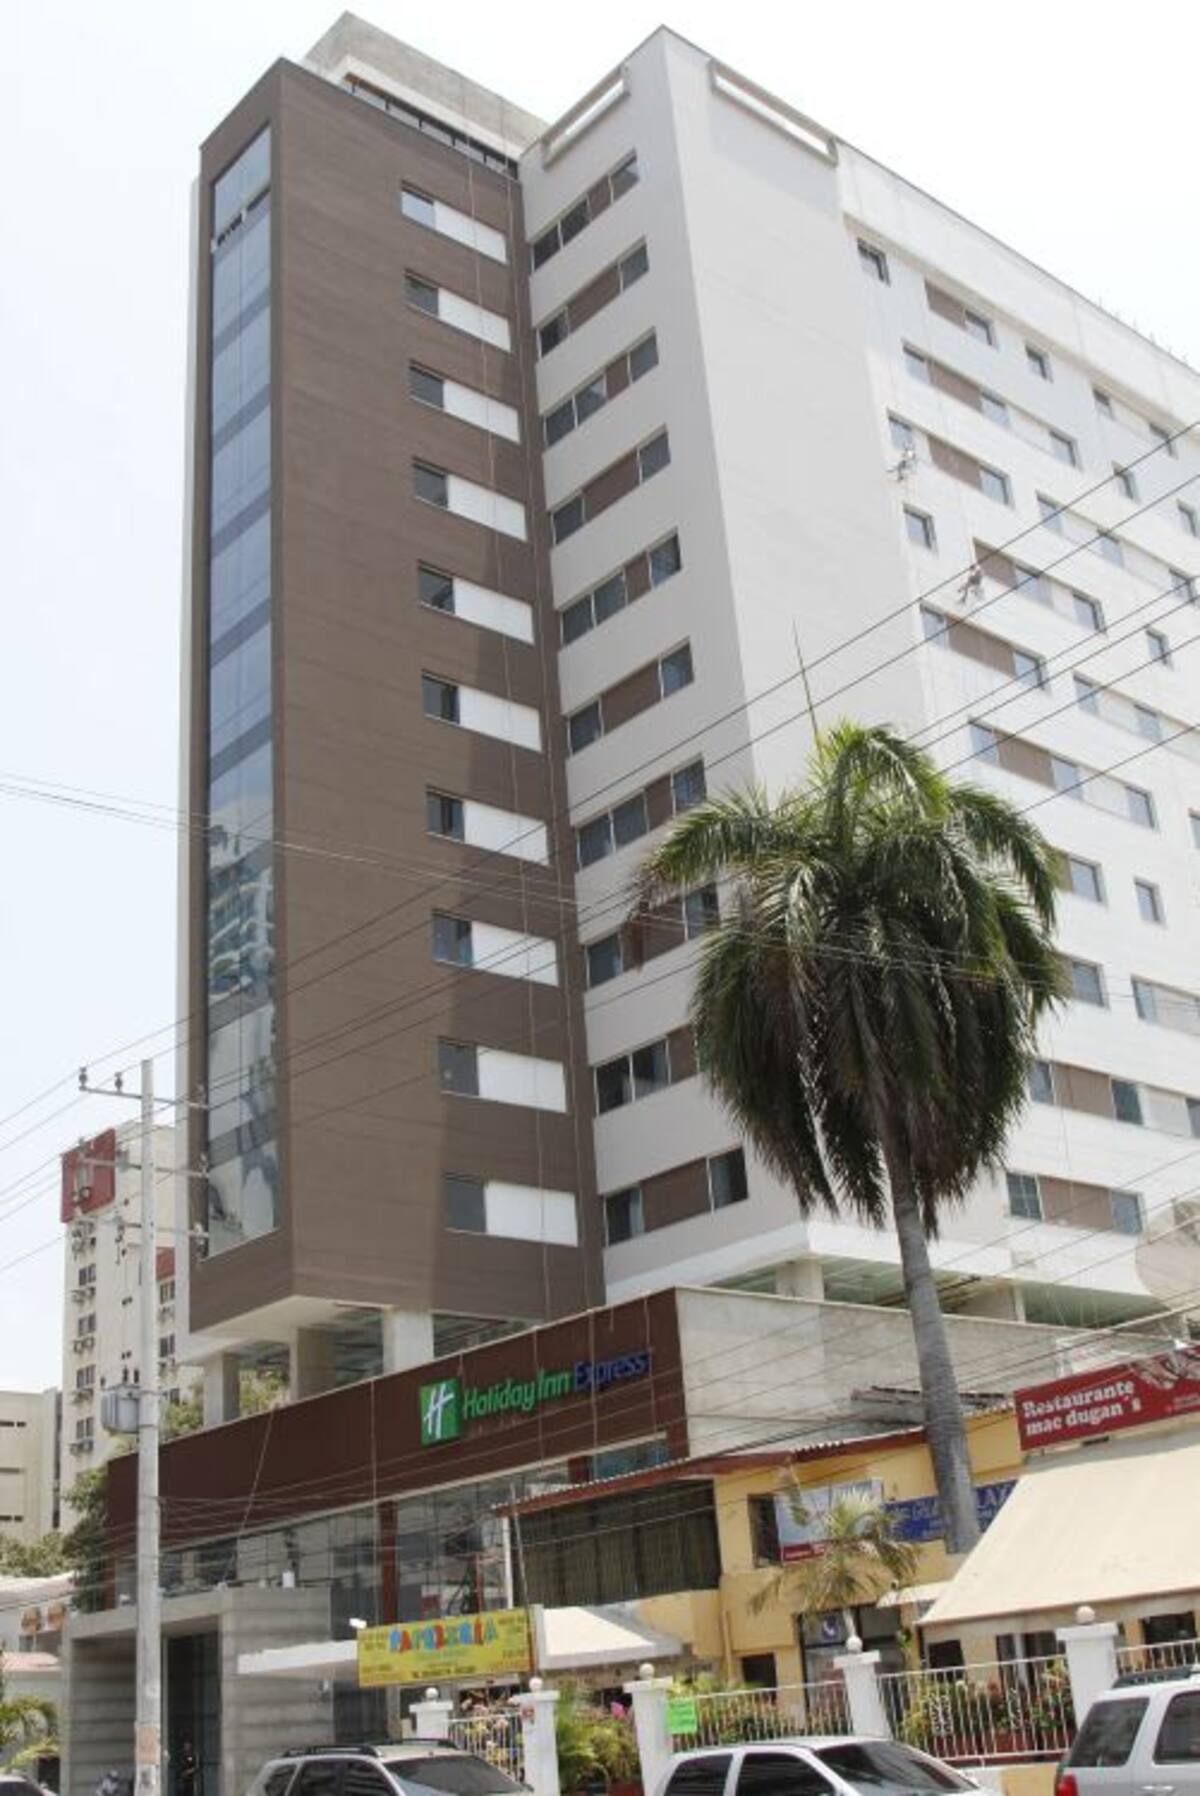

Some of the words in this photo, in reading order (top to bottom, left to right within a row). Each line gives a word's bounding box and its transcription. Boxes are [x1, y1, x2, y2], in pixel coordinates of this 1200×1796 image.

[464, 1378, 536, 1420] Holiday
[537, 1369, 570, 1400] Inn
[575, 1355, 650, 1391] Express
[1022, 1380, 1135, 1418] Restaurante
[1026, 1417, 1062, 1435] mac
